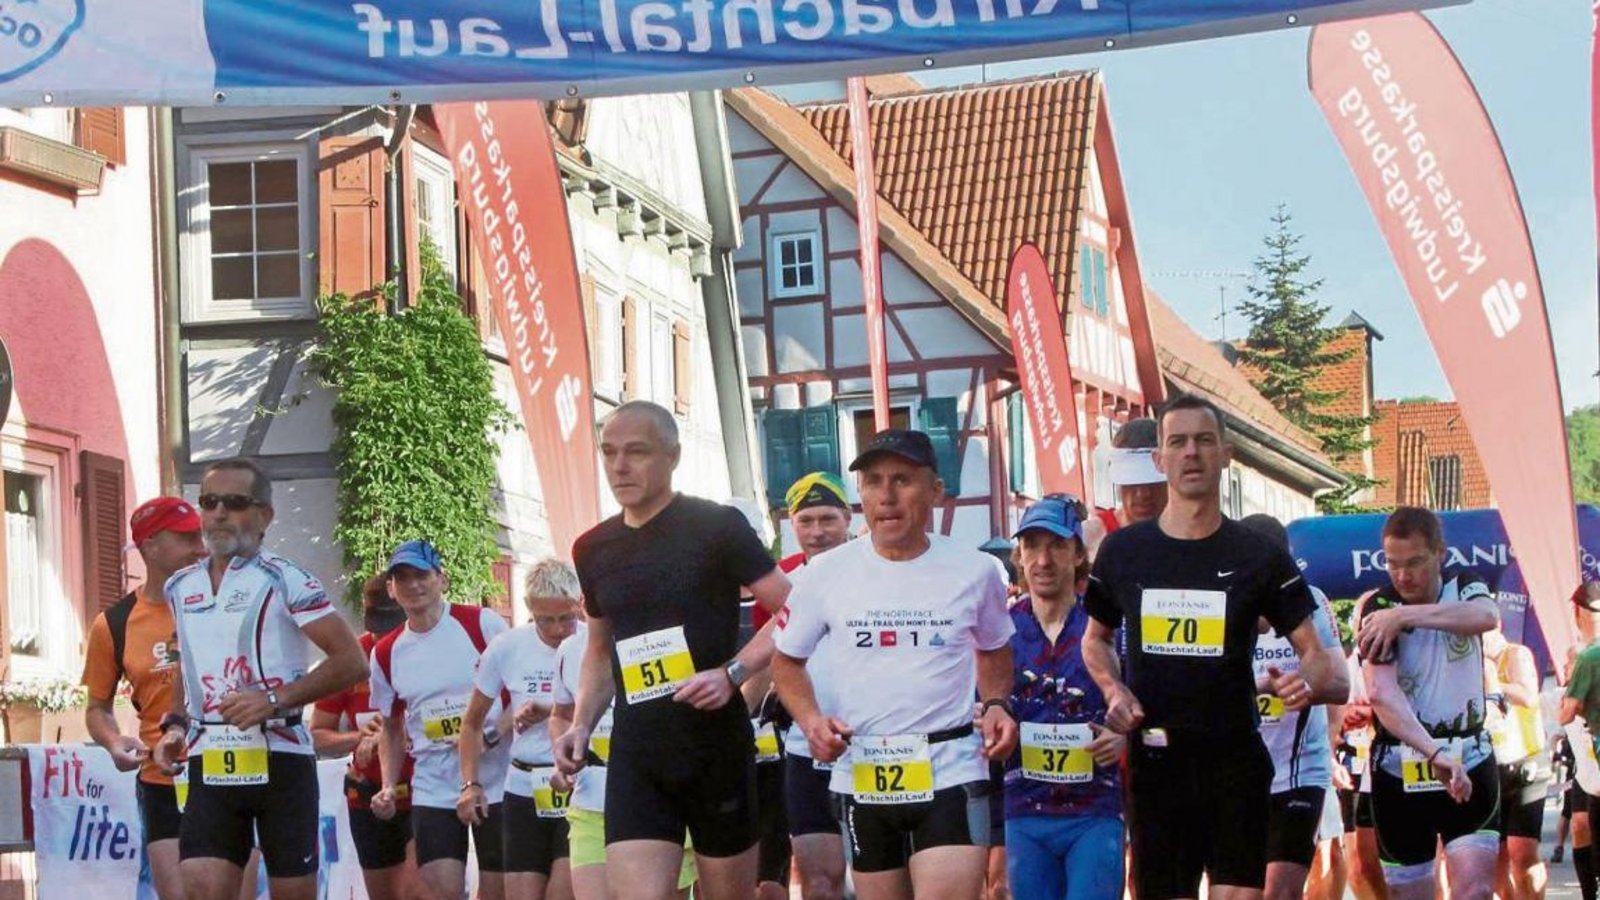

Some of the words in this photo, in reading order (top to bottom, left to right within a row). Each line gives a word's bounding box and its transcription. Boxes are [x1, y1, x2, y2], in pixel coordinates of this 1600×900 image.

[883, 610, 911, 618] NORTH
[913, 610, 933, 618] FACE
[856, 631, 873, 648] 2
[1167, 618, 1198, 644] 70
[640, 658, 670, 688] 51
[43, 746, 84, 799] Fit
[86, 777, 104, 799] for
[223, 750, 236, 774] 9
[1043, 748, 1070, 773] 37
[875, 765, 905, 792] 62
[69, 804, 137, 861] life.
